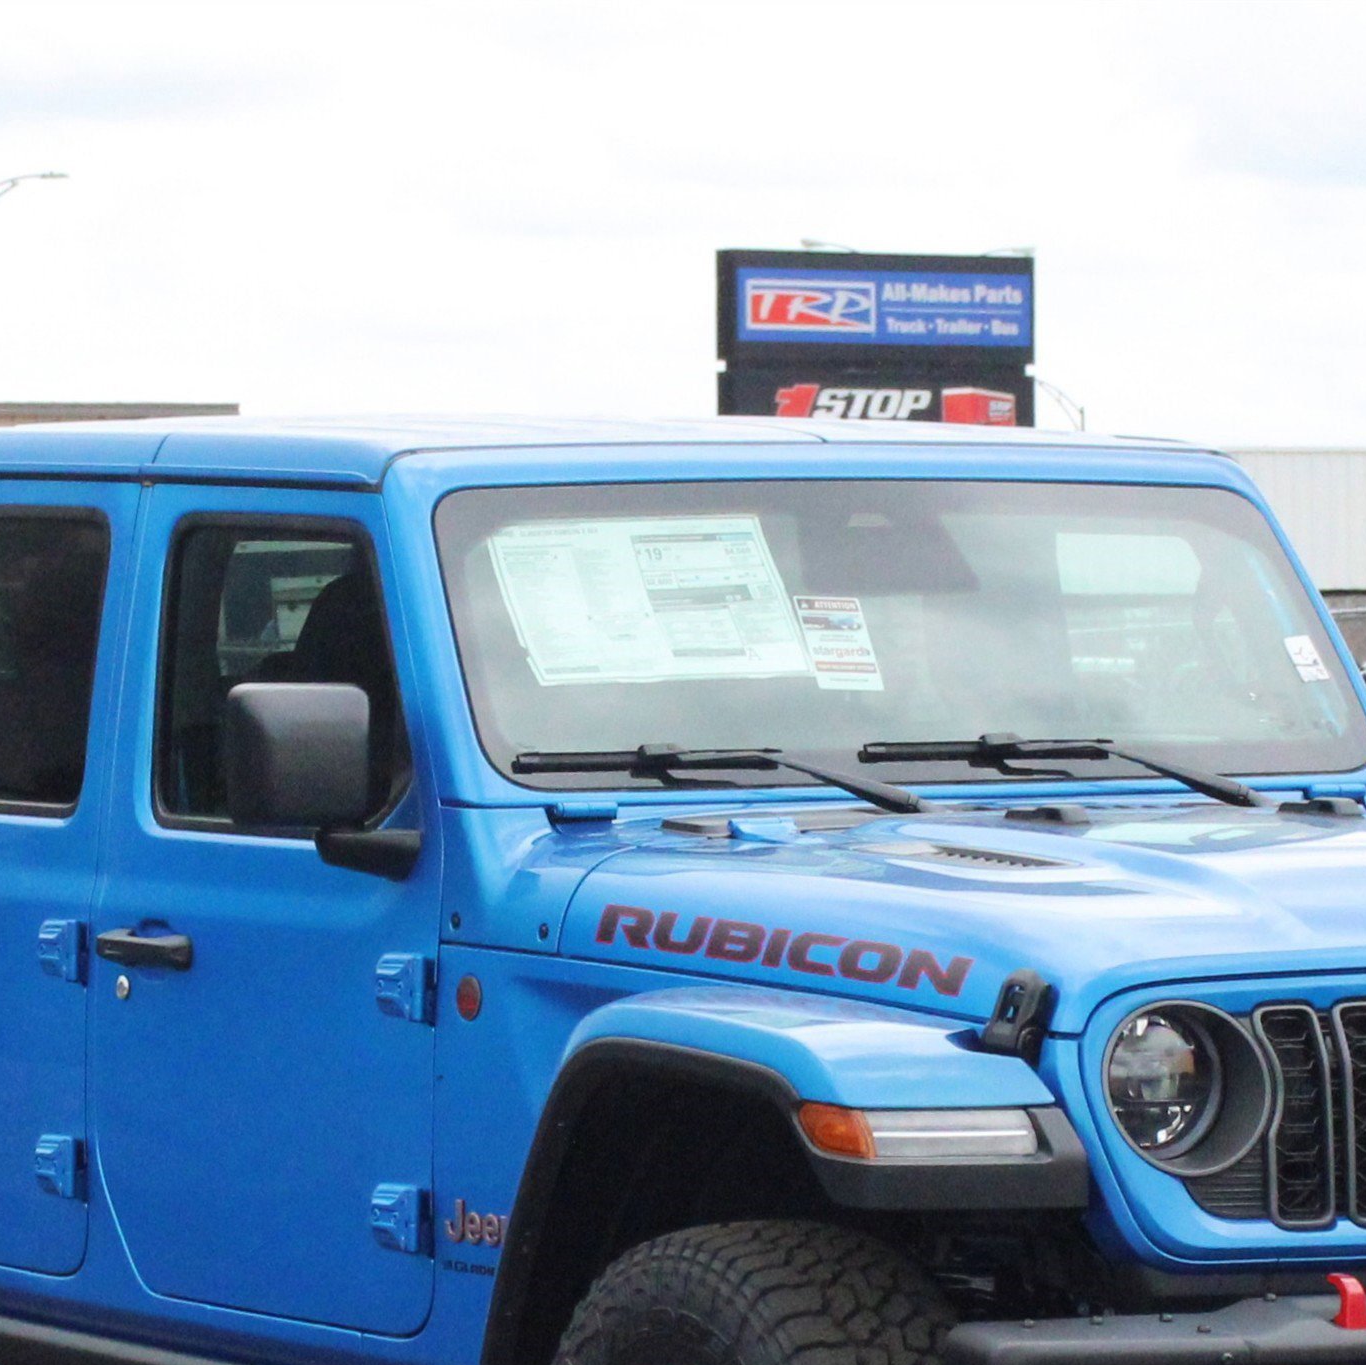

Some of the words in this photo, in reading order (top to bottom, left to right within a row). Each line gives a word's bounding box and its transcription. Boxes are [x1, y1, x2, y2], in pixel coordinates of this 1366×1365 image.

[882, 282, 972, 303] All-Makes
[973, 284, 1023, 305] Parts
[748, 288, 874, 325] TRP
[886, 317, 927, 334] Truck
[935, 318, 983, 335] Trailer
[991, 320, 1020, 336] Bus
[813, 387, 933, 420] STOP
[644, 547, 663, 561] 19
[813, 600, 857, 610] ATTENTION
[594, 903, 976, 998] RUBICON
